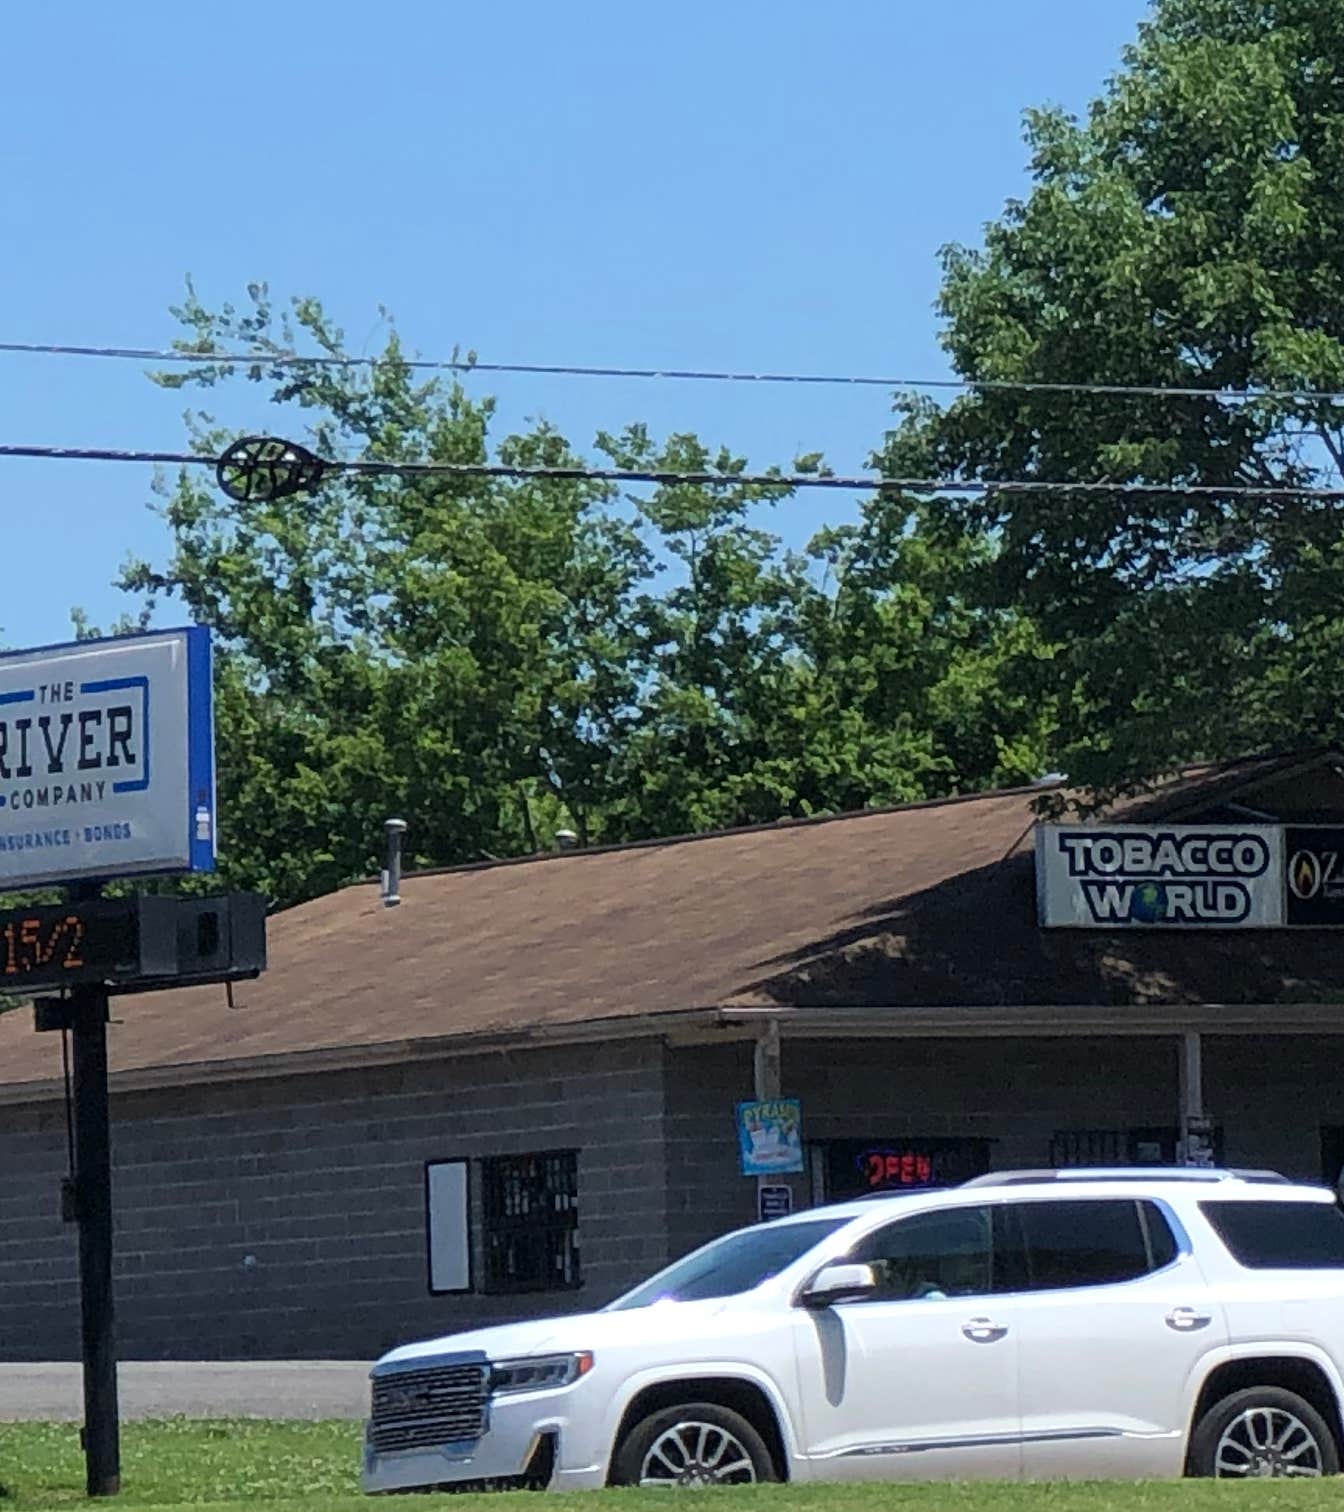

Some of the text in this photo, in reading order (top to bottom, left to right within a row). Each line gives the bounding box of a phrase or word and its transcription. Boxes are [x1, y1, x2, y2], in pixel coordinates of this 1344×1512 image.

[39, 681, 75, 704] THE
[10, 780, 106, 811] COMPANY
[84, 822, 132, 843] BONDS
[1060, 833, 1270, 877] TOBACCO
[1081, 879, 1252, 924] WORLD
[868, 1154, 932, 1185] OPEN
